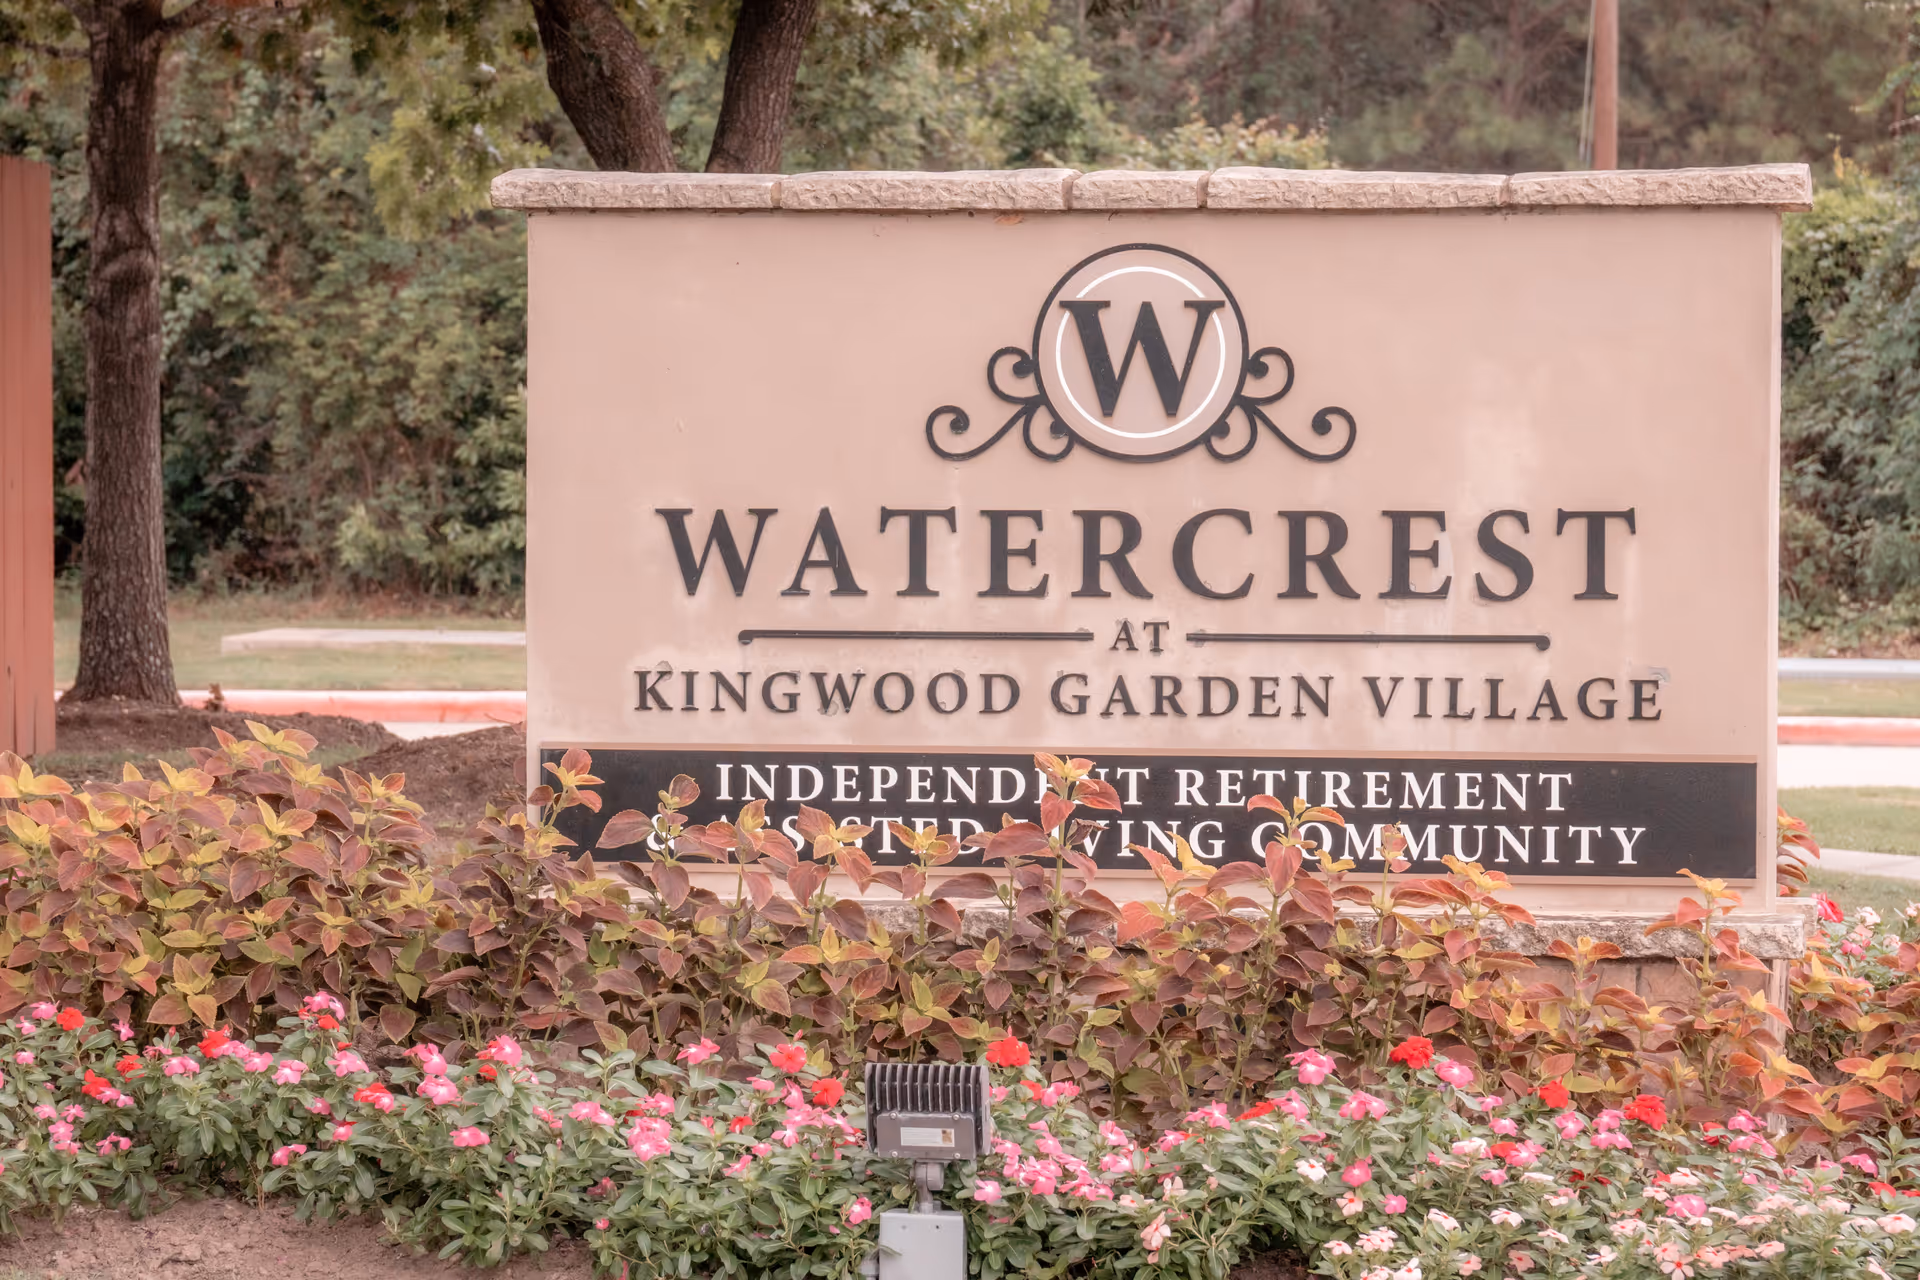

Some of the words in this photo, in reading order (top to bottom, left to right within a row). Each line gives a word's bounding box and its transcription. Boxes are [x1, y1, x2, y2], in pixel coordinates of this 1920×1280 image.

[1059, 300, 1225, 417] W
[655, 506, 1636, 601] WATERCREST
[1109, 620, 1170, 653] AT
[634, 670, 1020, 714] KINGWOOD
[1050, 672, 1335, 718] GARDEN
[1362, 675, 1662, 721] VILLAGE
[1174, 768, 1572, 812] RETIREMENT
[1004, 818, 1226, 859] VING
[1251, 820, 1646, 865] COMMUNITY
